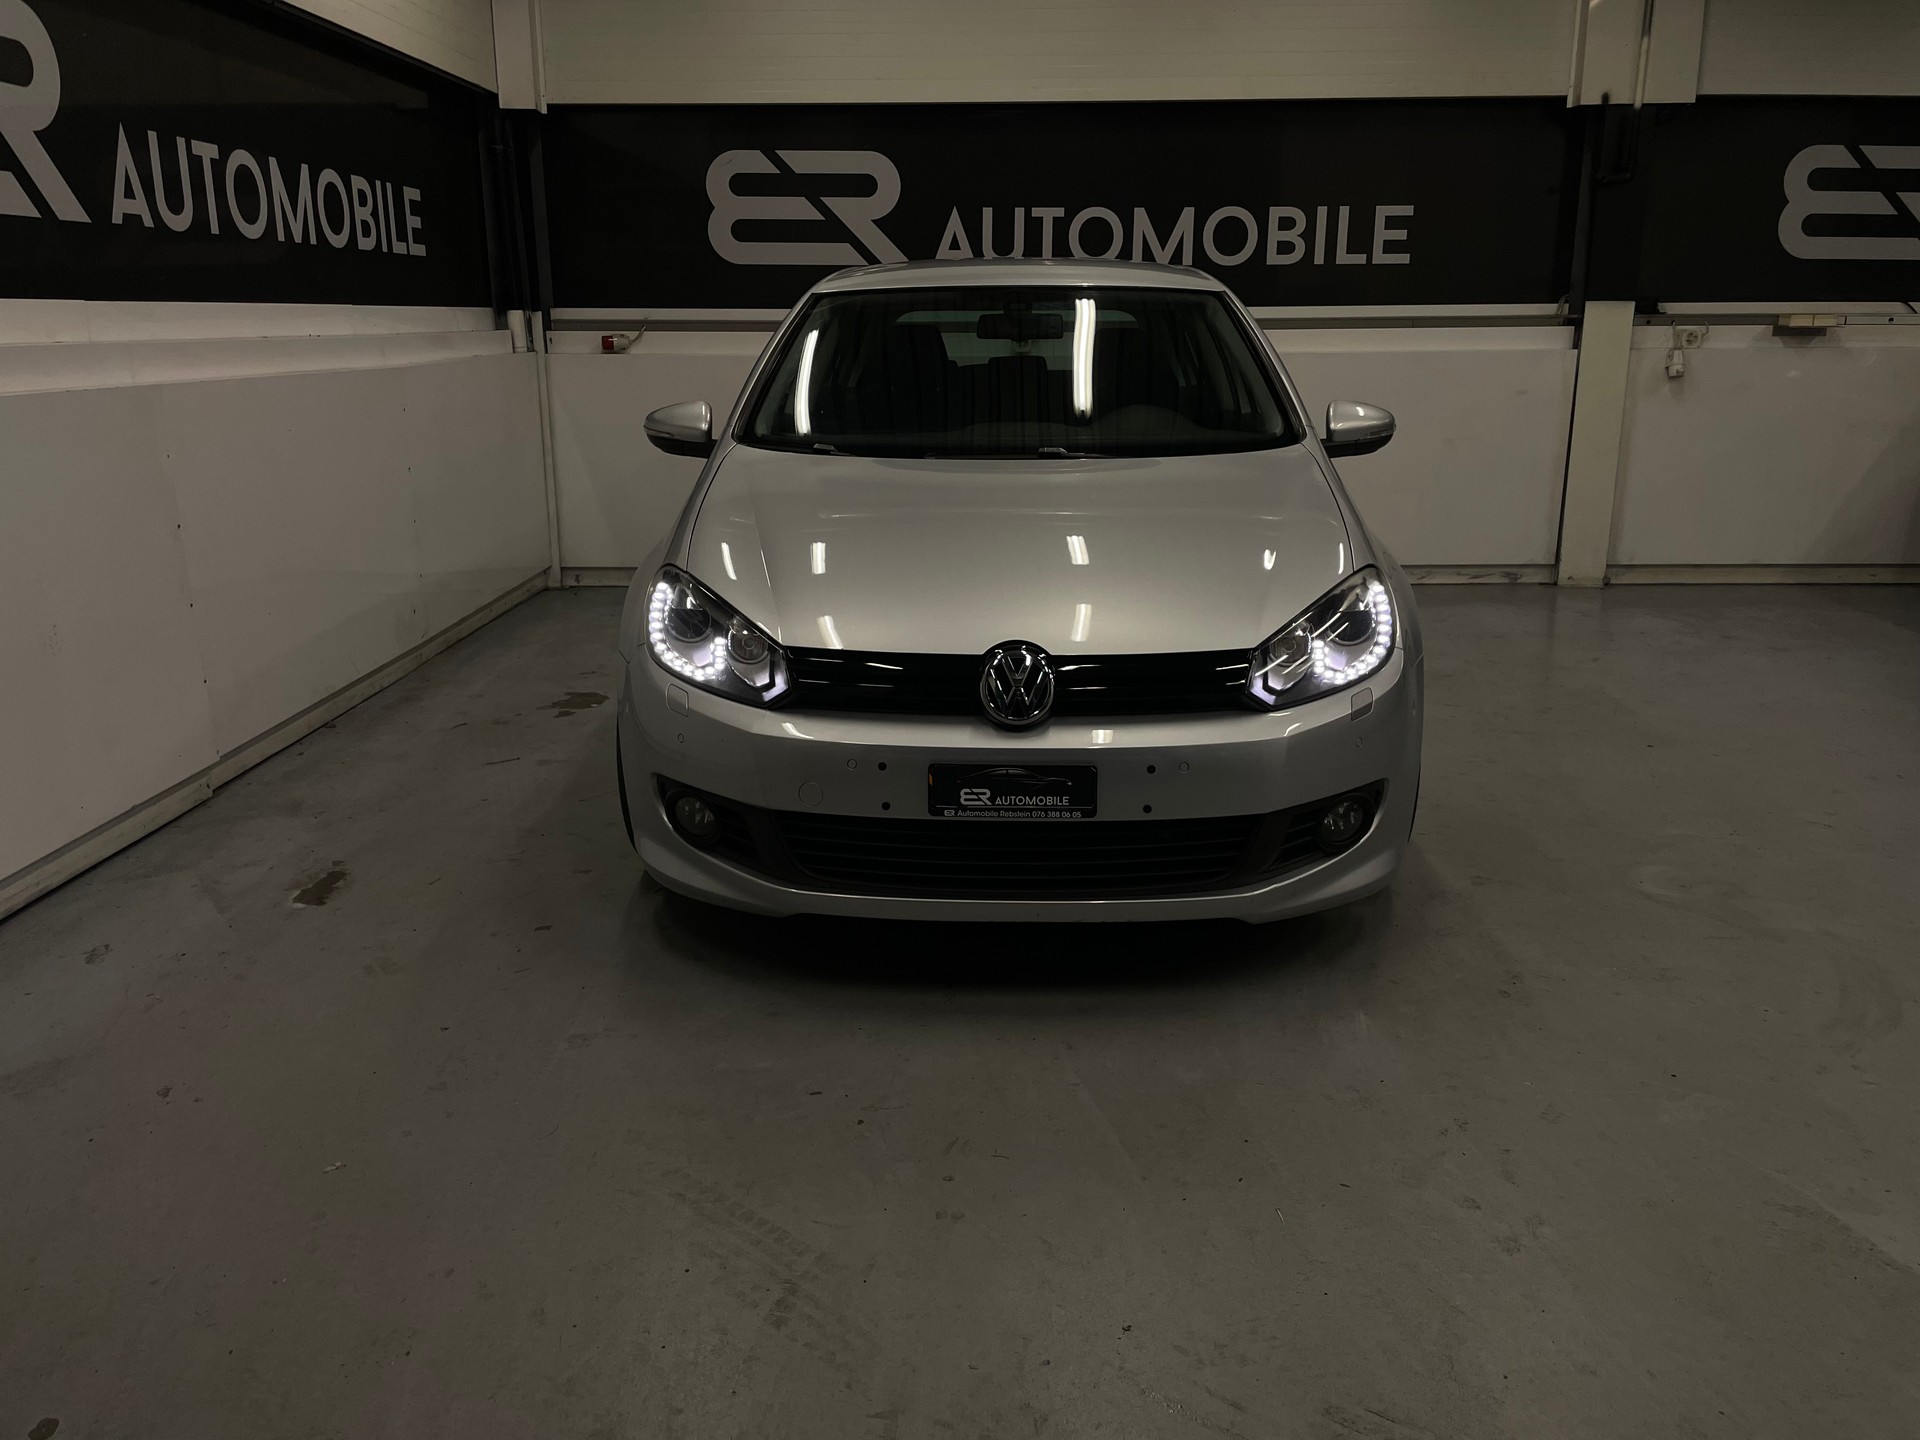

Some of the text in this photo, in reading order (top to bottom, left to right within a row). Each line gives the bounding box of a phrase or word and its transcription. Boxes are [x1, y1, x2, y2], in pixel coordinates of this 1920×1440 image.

[111, 121, 427, 257] AUTOMOBILE
[935, 204, 1415, 266] AUTOMOBILE
[957, 809, 998, 817] Automobile
[1000, 810, 1031, 818] Rebstein
[1032, 810, 1046, 818] 076
[1047, 810, 1060, 818] 388
[1061, 811, 1071, 819] 06
[1072, 811, 1082, 819] 05
[995, 796, 1070, 806] AUTOMOBILE
